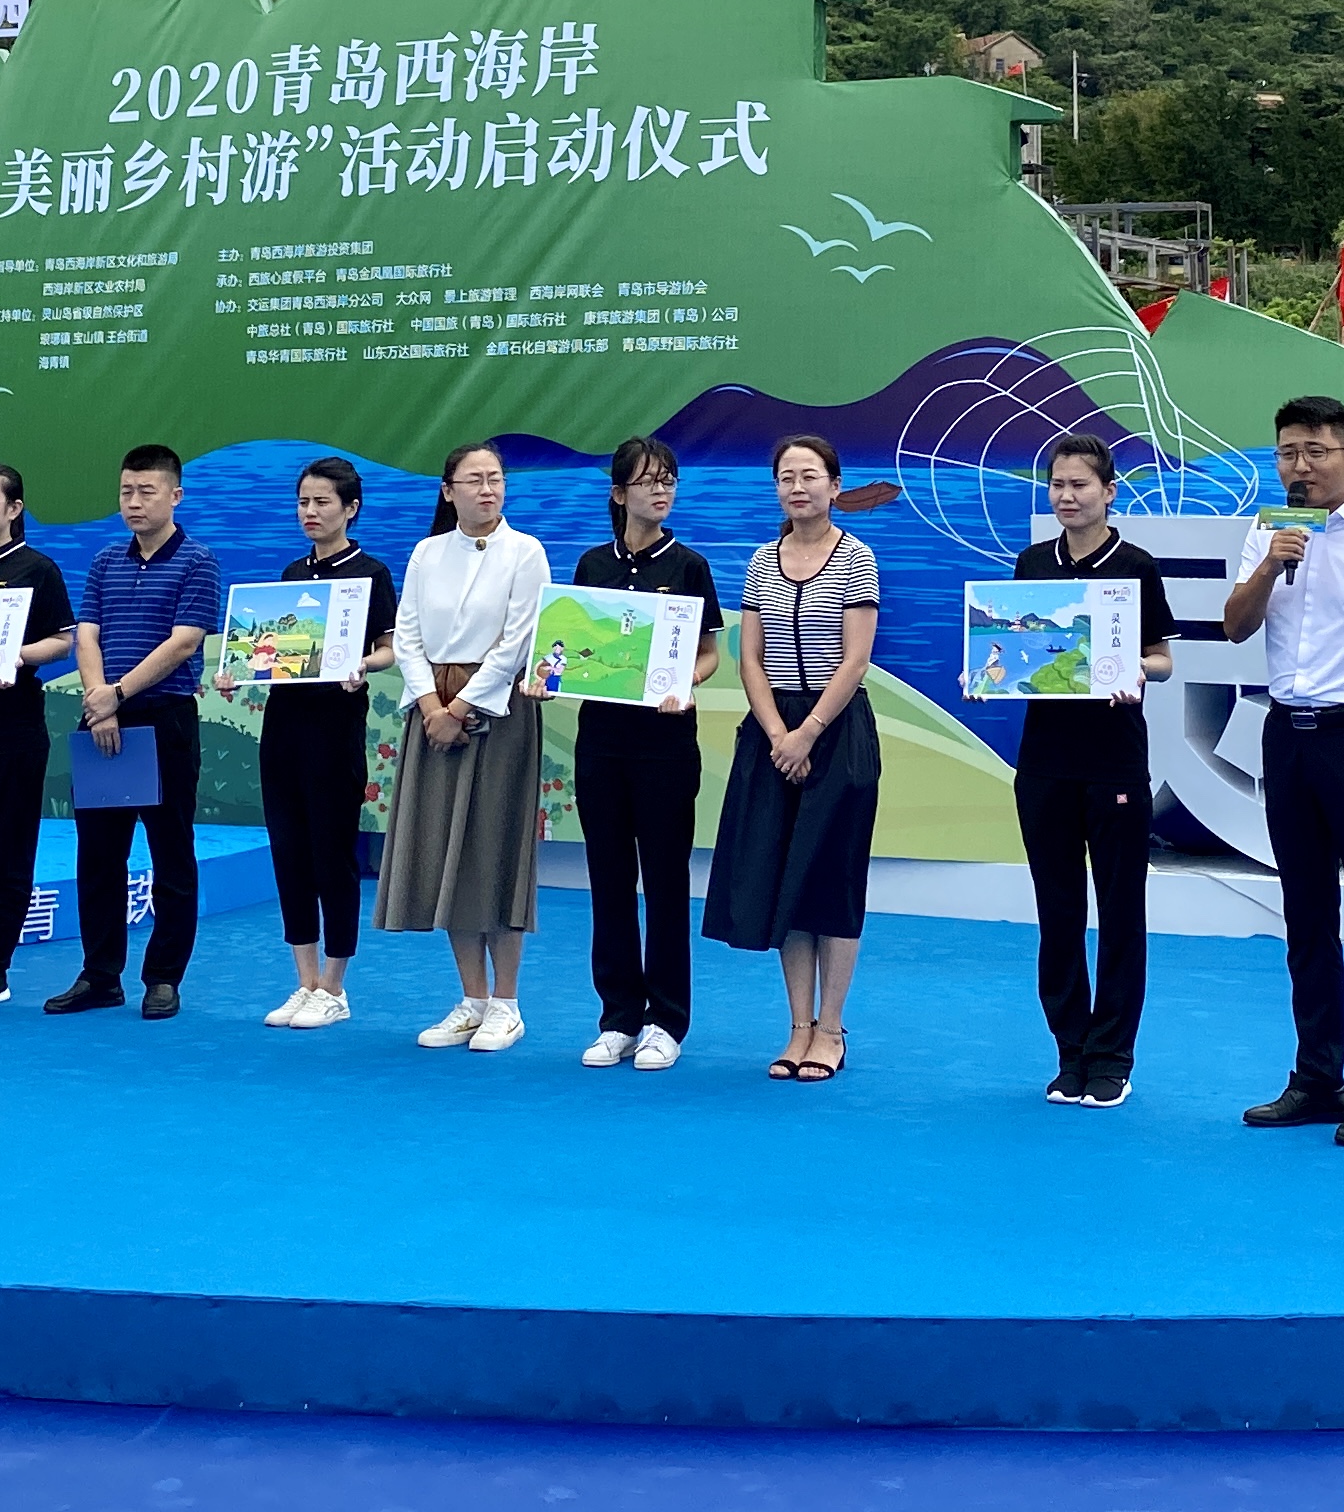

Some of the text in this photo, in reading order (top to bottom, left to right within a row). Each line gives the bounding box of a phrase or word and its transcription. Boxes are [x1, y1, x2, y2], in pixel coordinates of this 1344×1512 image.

[108, 20, 600, 124] 2020青岛西海岸
[42, 278, 146, 297] 西海岸新区农业农村局
[395, 289, 432, 307] 大众网
[617, 279, 709, 298] 青岛市导游协会
[362, 342, 470, 361] 山东万达国际旅行社
[622, 334, 740, 352] 青岛原野国际旅行社
